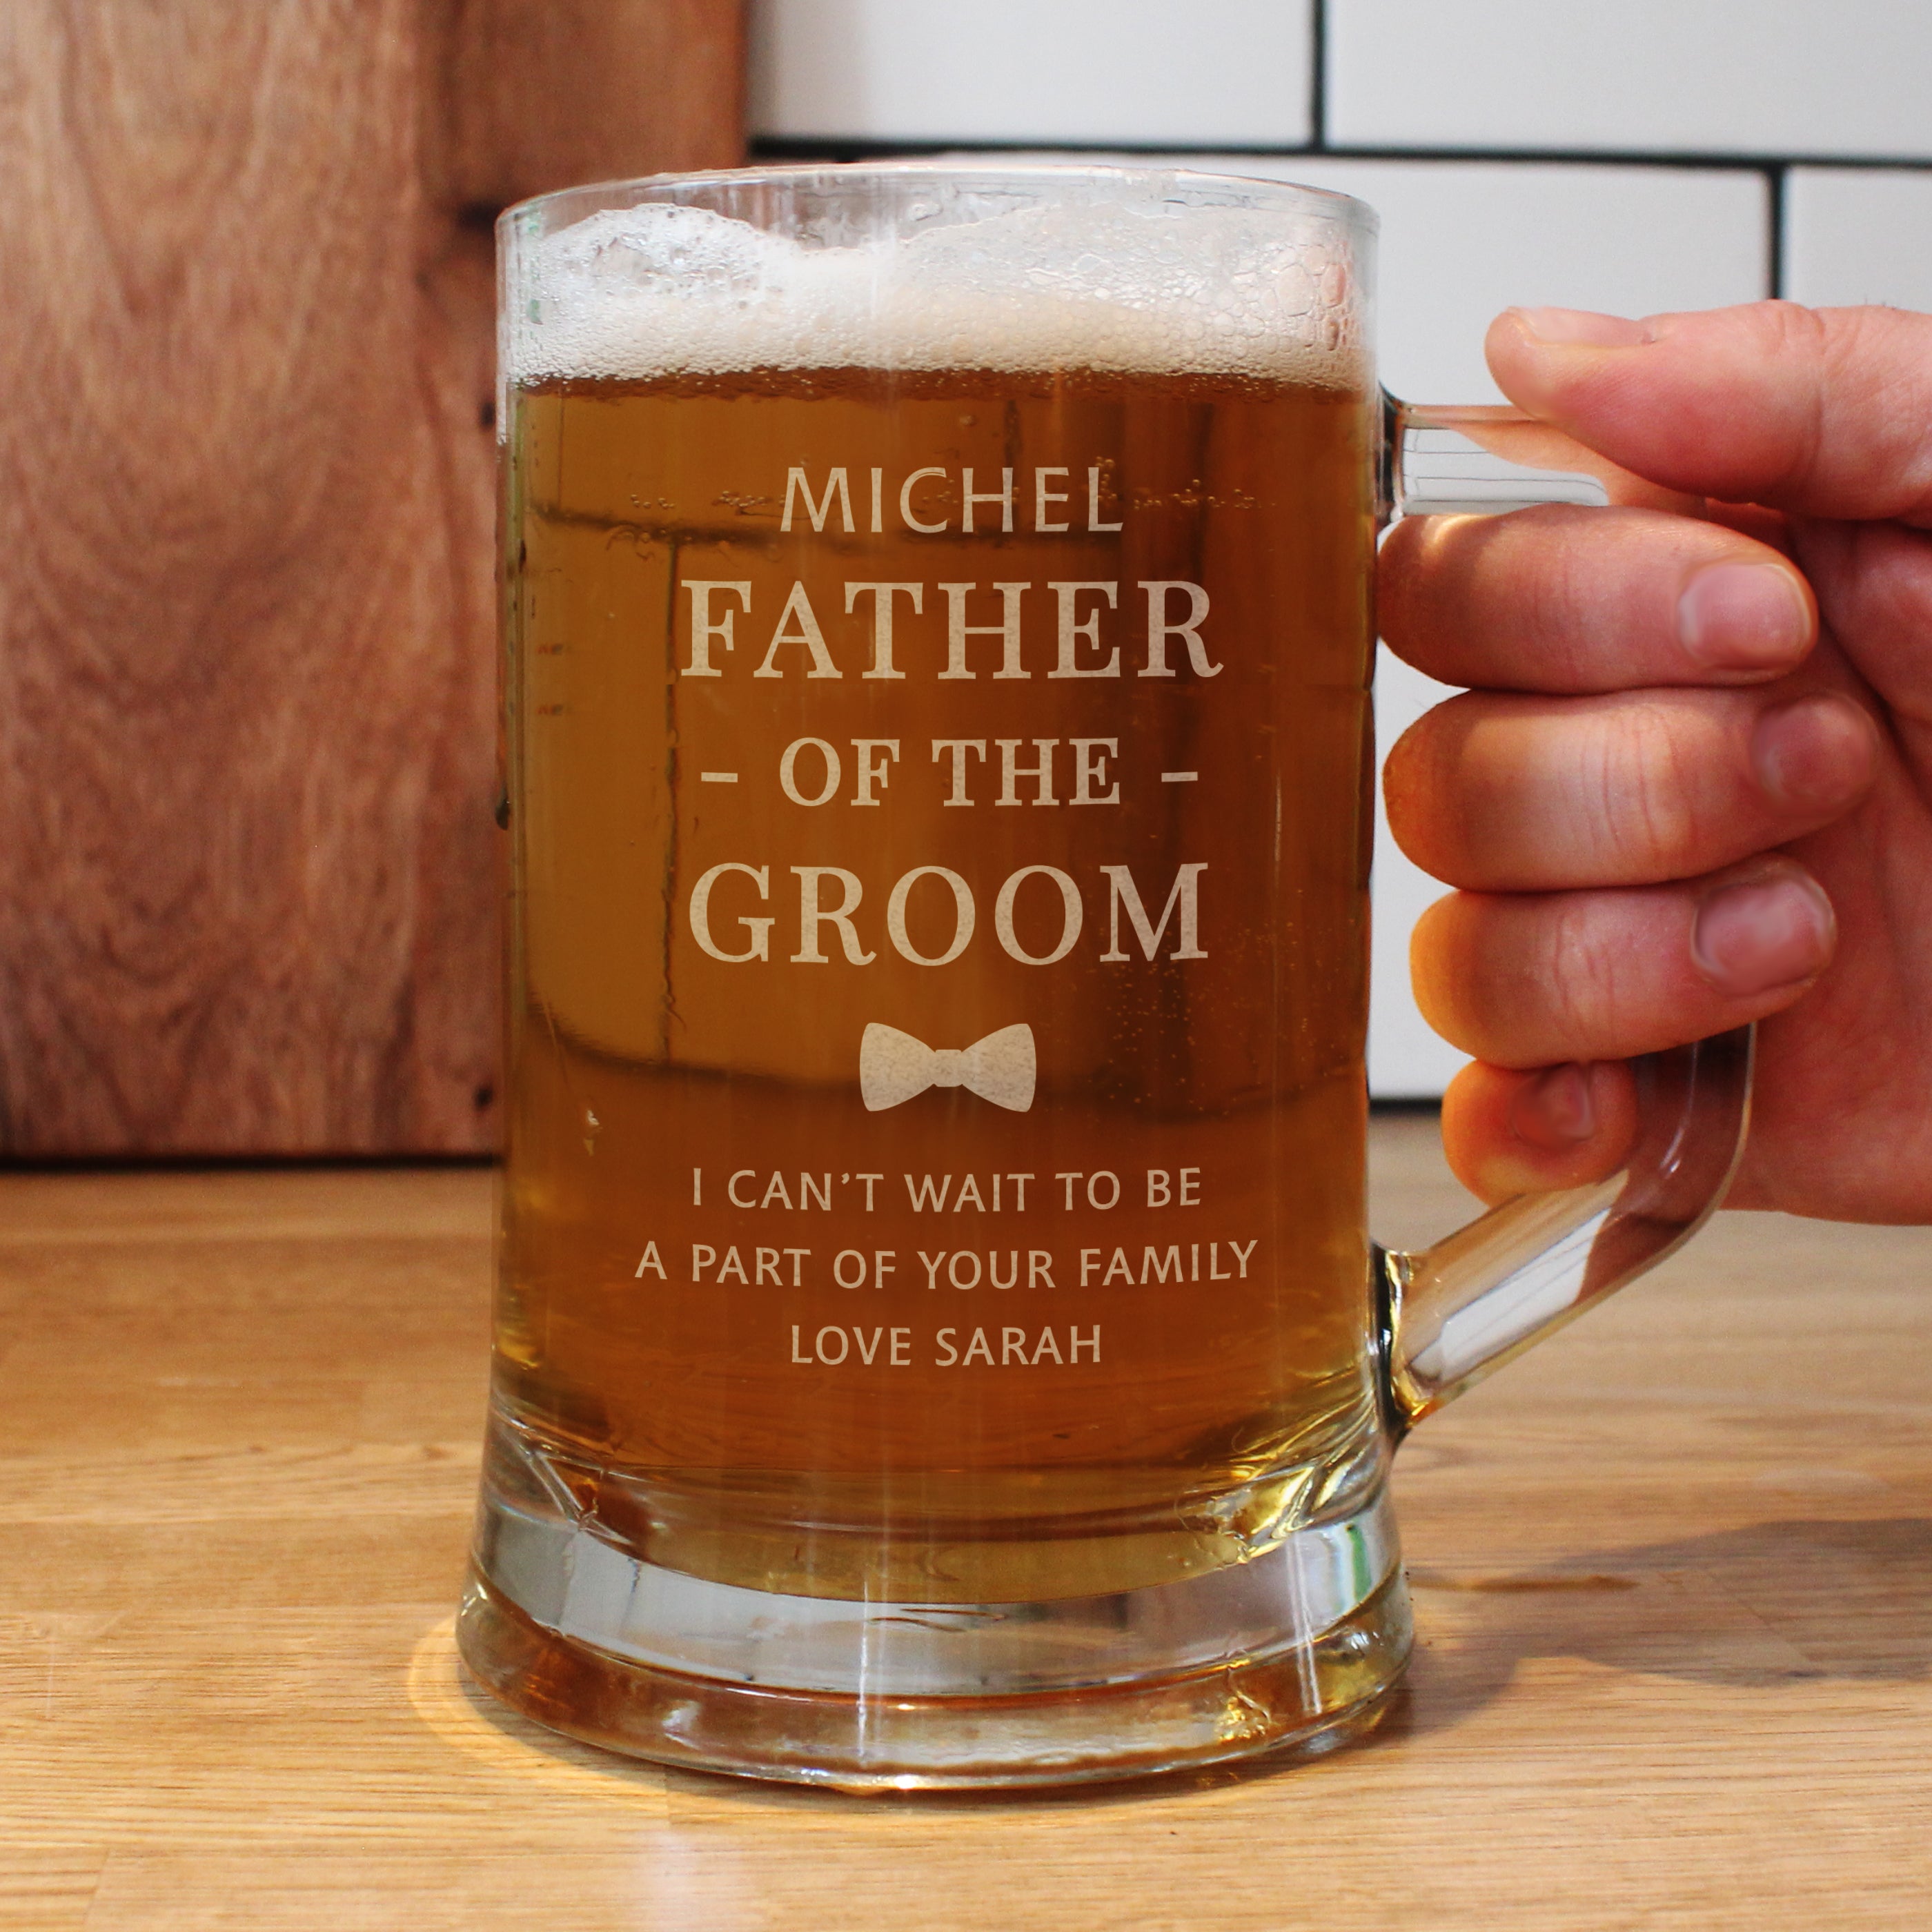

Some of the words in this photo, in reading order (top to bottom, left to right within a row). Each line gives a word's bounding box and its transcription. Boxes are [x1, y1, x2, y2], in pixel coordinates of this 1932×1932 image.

[781, 466, 1123, 533] MICHEL
[681, 580, 1224, 679] FATHER
[780, 738, 900, 806] OF
[931, 738, 1120, 806] THE
[689, 862, 1208, 965] GROOM
[693, 1168, 701, 1205] I
[728, 1170, 884, 1211] CAN'T
[904, 1174, 1035, 1212] WAIT
[1055, 1171, 1120, 1210] TO
[1147, 1167, 1201, 1207] BE
[635, 1241, 667, 1279] A
[692, 1244, 811, 1286] PART
[834, 1250, 896, 1288] OF
[916, 1250, 1056, 1290] YOUR
[1081, 1240, 1258, 1287] FAMILY
[791, 1325, 911, 1366] LOVE
[936, 1325, 1101, 1367] SARAH
